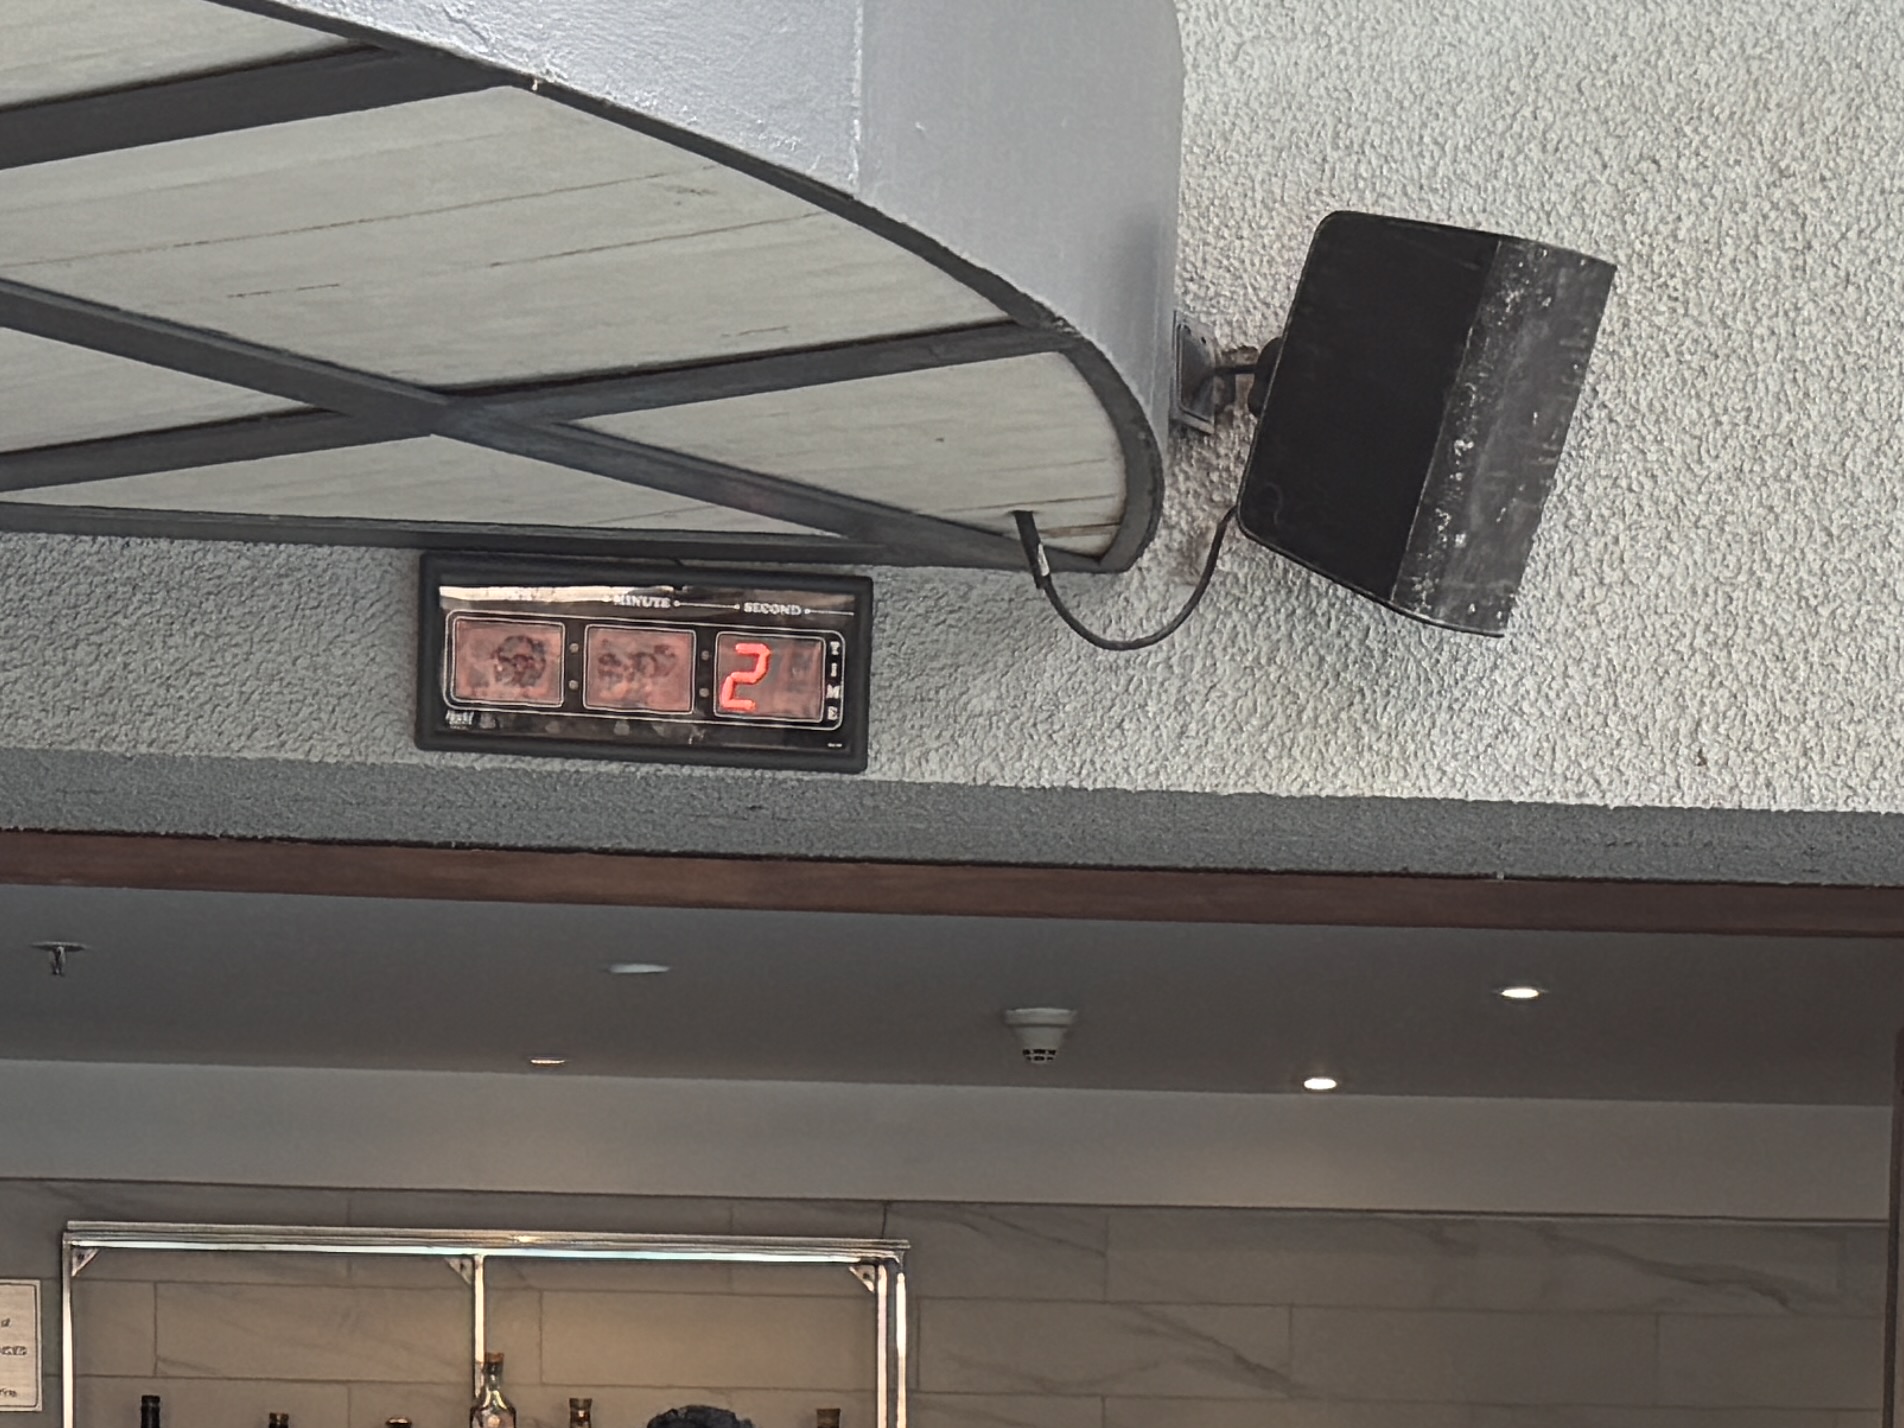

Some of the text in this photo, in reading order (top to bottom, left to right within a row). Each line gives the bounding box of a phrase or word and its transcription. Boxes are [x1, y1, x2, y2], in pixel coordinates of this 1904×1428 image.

[614, 597, 802, 615] MINUTE SECOND
[720, 643, 772, 712] 2
